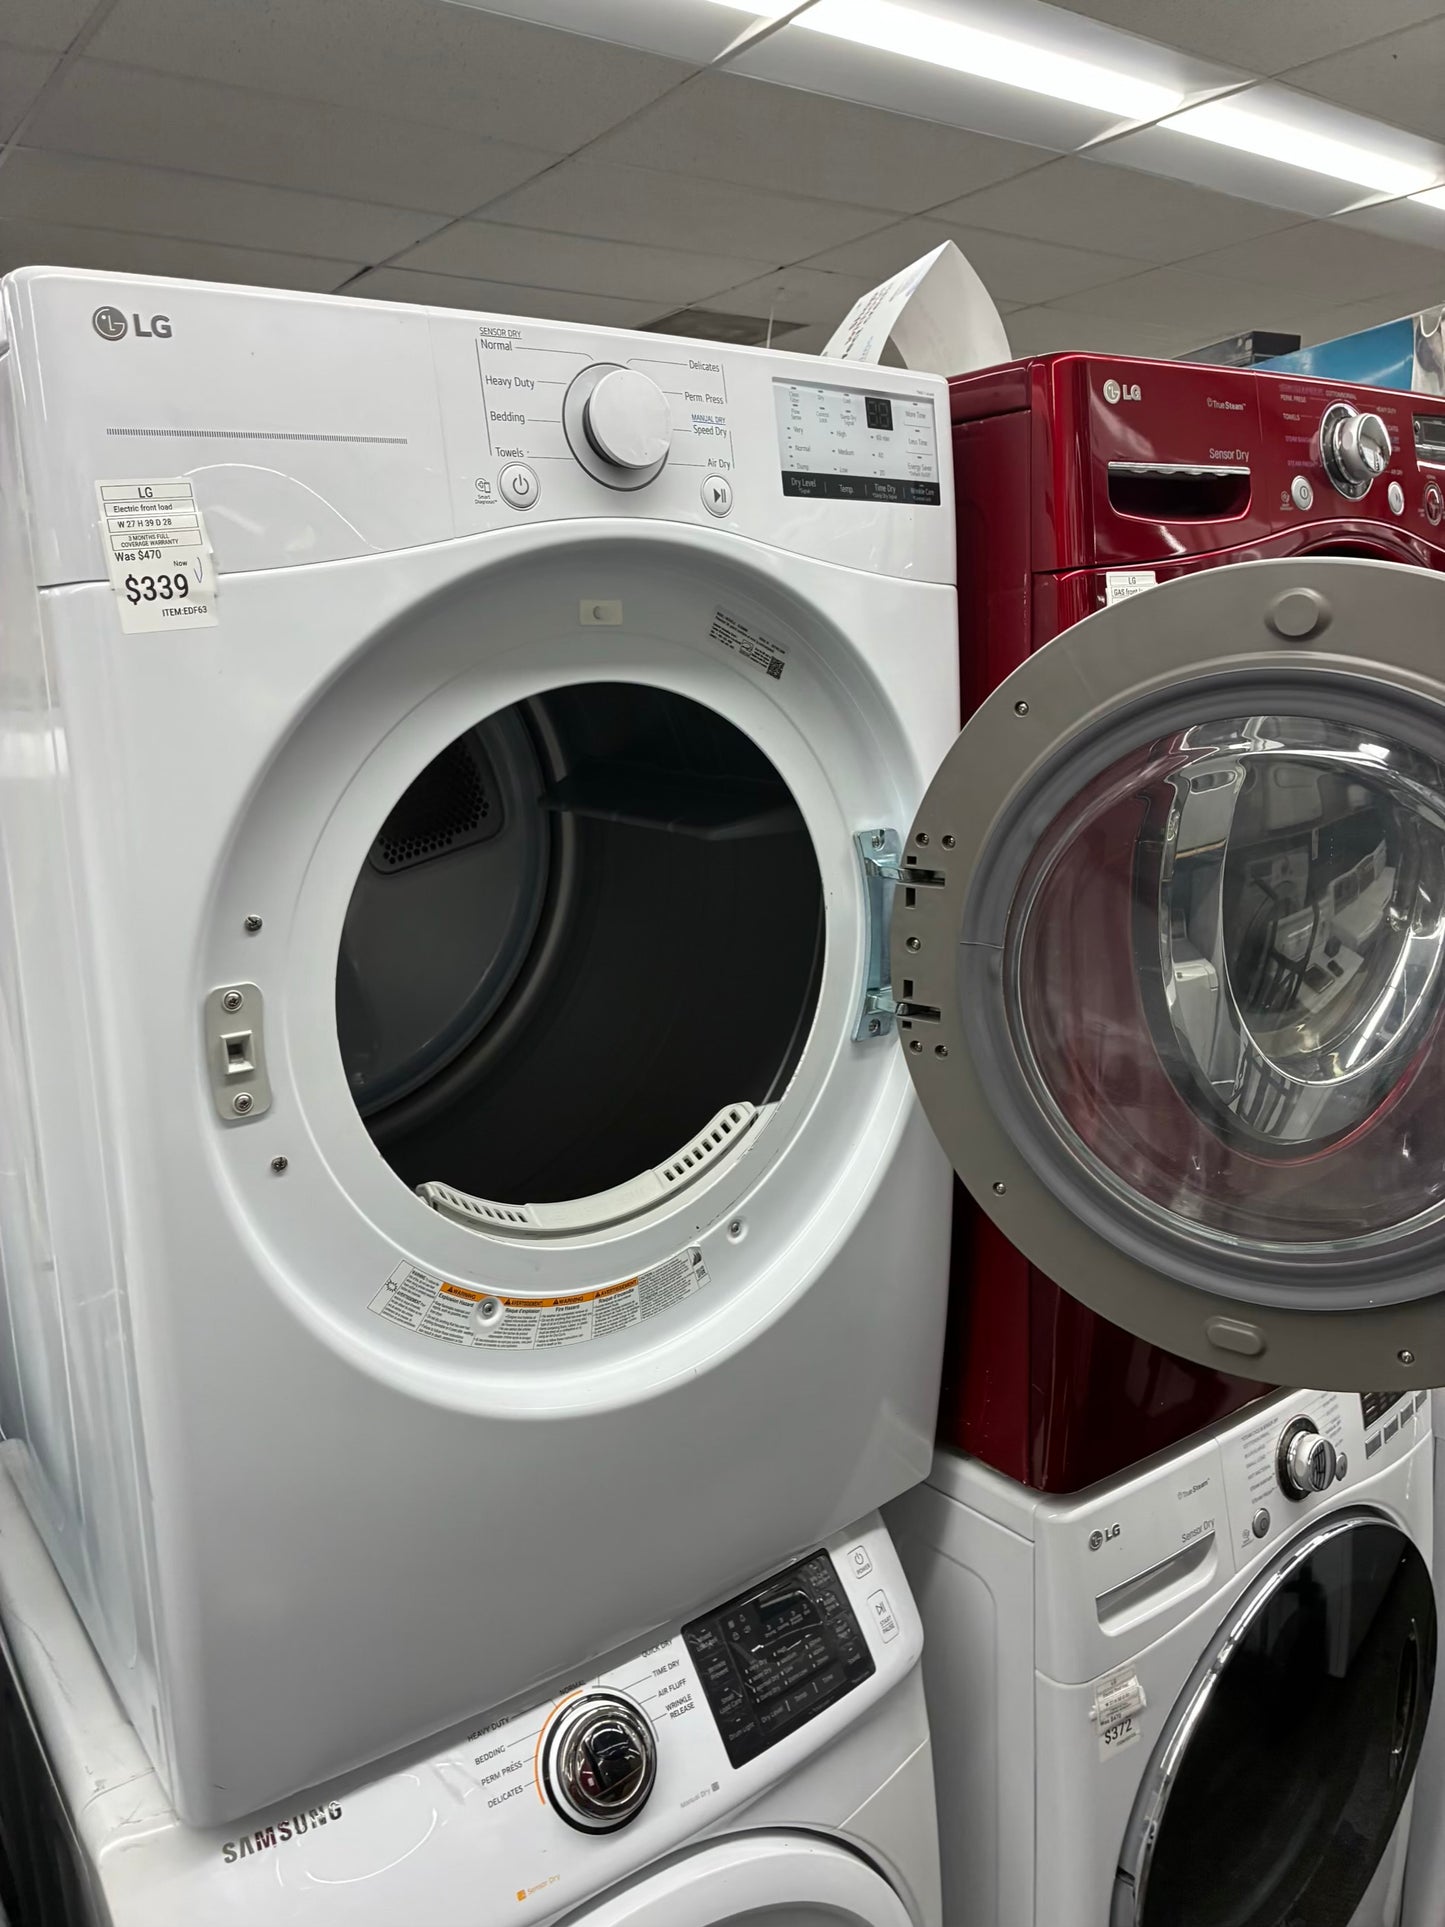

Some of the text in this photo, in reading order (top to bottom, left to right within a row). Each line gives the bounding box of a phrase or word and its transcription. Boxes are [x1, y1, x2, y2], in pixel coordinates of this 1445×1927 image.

[133, 313, 173, 339] LG
[479, 327, 521, 338] SENSOR DRY
[480, 339, 513, 351] Normal
[689, 360, 720, 372] Delicates
[485, 375, 535, 390] Heavy Duty
[685, 391, 724, 405] Perm. Press
[490, 411, 525, 425] Bedding
[691, 414, 726, 424] MANUAL DRY
[693, 424, 727, 439] Speed Dry
[495, 447, 525, 457] Towels
[1209, 448, 1250, 463] Sensor Dry
[707, 458, 731, 471] Air Dry
[791, 477, 816, 488] Dry Level
[874, 483, 896, 494] Time Dry
[137, 486, 153, 498] LG
[113, 505, 139, 513] Electric
[140, 504, 157, 512] front
[126, 520, 135, 528] 27
[145, 519, 154, 527] 39
[163, 518, 172, 526] 28
[121, 538, 179, 548] COVERAGE WARRANTY
[114, 549, 162, 562] Was $470
[1128, 576, 1136, 585] LG
[125, 573, 189, 606] $339
[1113, 588, 1125, 596] GAS
[162, 606, 208, 617] ITEM:EDF63
[1181, 1518, 1215, 1543] Sensor Dry
[641, 1639, 672, 1657] QUICK DRY
[652, 1659, 680, 1677] TIME DRY
[559, 1680, 587, 1695] NORMAL
[658, 1678, 687, 1698] AIR FLUFF
[665, 1693, 693, 1712] WRINKLE
[669, 1701, 696, 1719] RELEASE
[467, 1716, 510, 1742] HEAVY DUTY
[1104, 1719, 1132, 1745] $372
[474, 1744, 506, 1766] BEDDING
[481, 1760, 523, 1786] PERM PRESS
[487, 1784, 524, 1808] DELICATES
[222, 1800, 343, 1864] SAMSUNG
